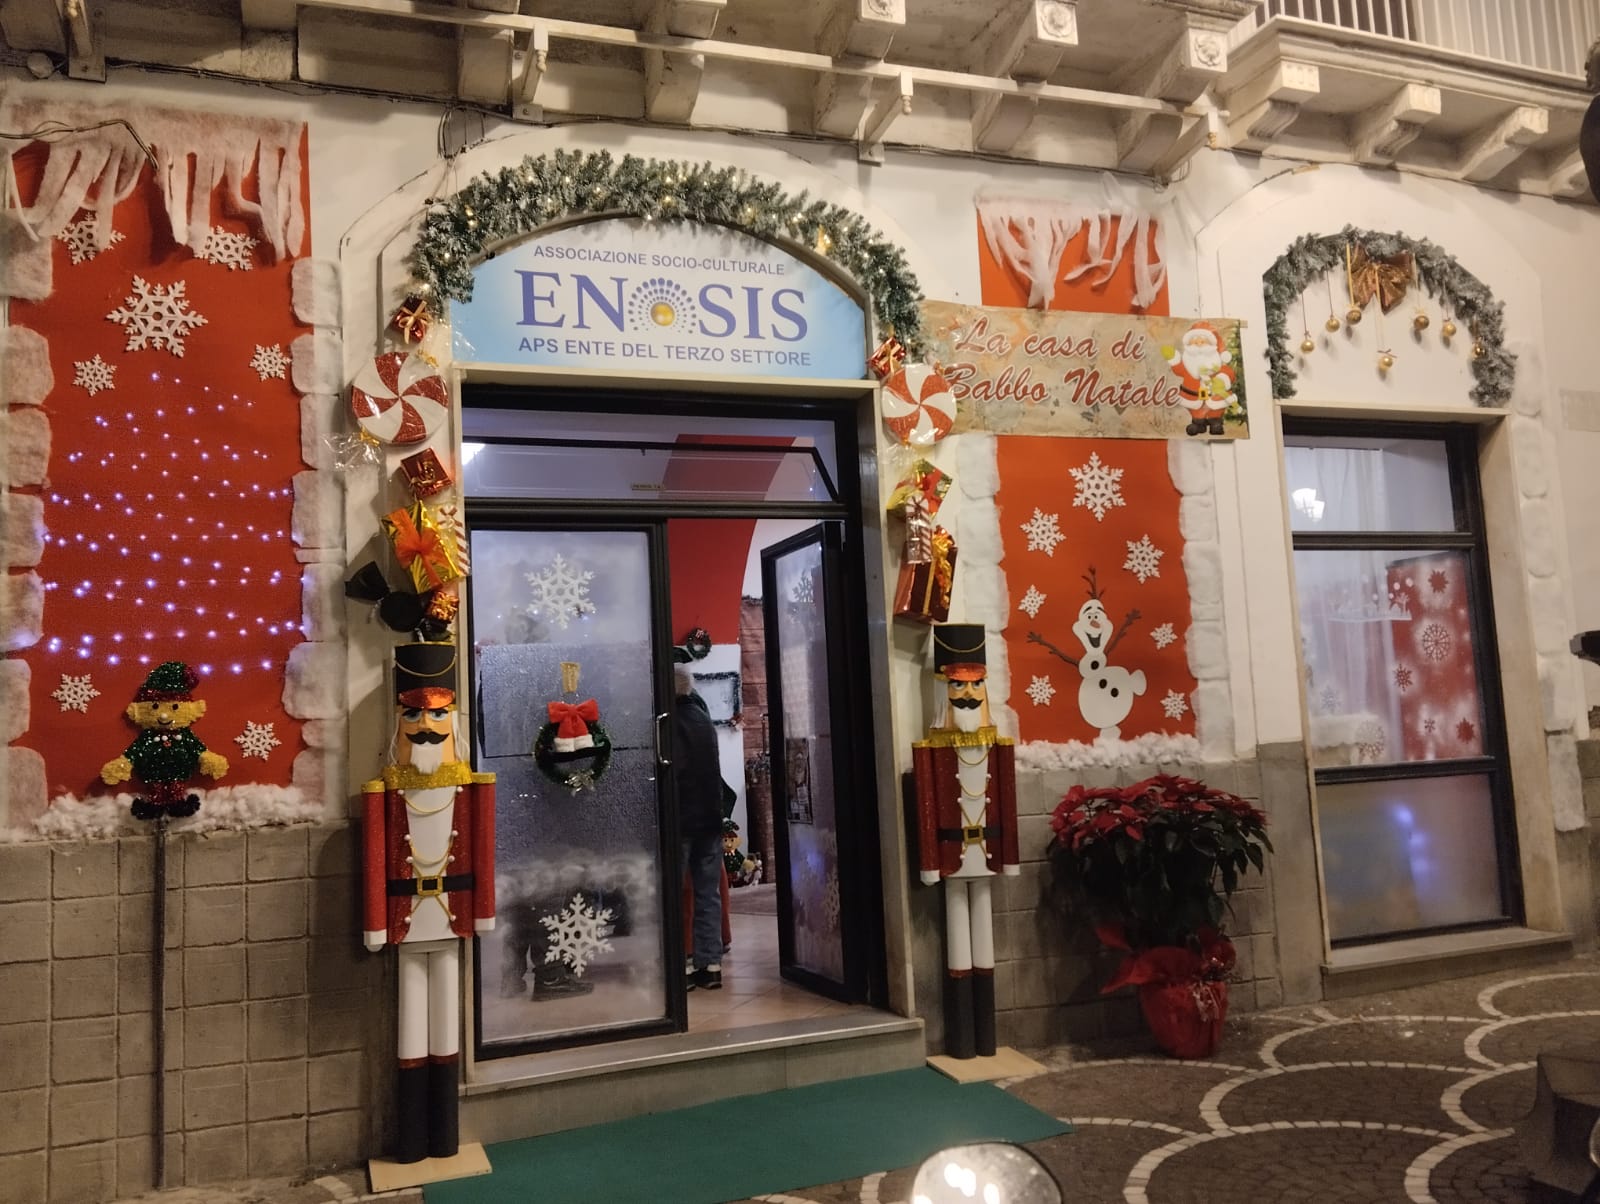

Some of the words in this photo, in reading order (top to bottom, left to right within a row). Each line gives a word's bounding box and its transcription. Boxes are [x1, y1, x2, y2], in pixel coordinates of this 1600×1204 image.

[534, 245, 647, 265] ASSOCIAZIONE
[652, 254, 785, 275] SOCIO-CULTURALE
[518, 337, 558, 353] APS
[565, 340, 616, 357] ENTE
[622, 342, 659, 359] DEL
[664, 345, 725, 362] TERZO
[730, 349, 812, 366] SETTORE
[955, 316, 1009, 353] La
[1024, 334, 1097, 359] casa
[1112, 330, 1144, 360] di
[944, 363, 1048, 401] Babbo
[1064, 368, 1180, 408] Natale
